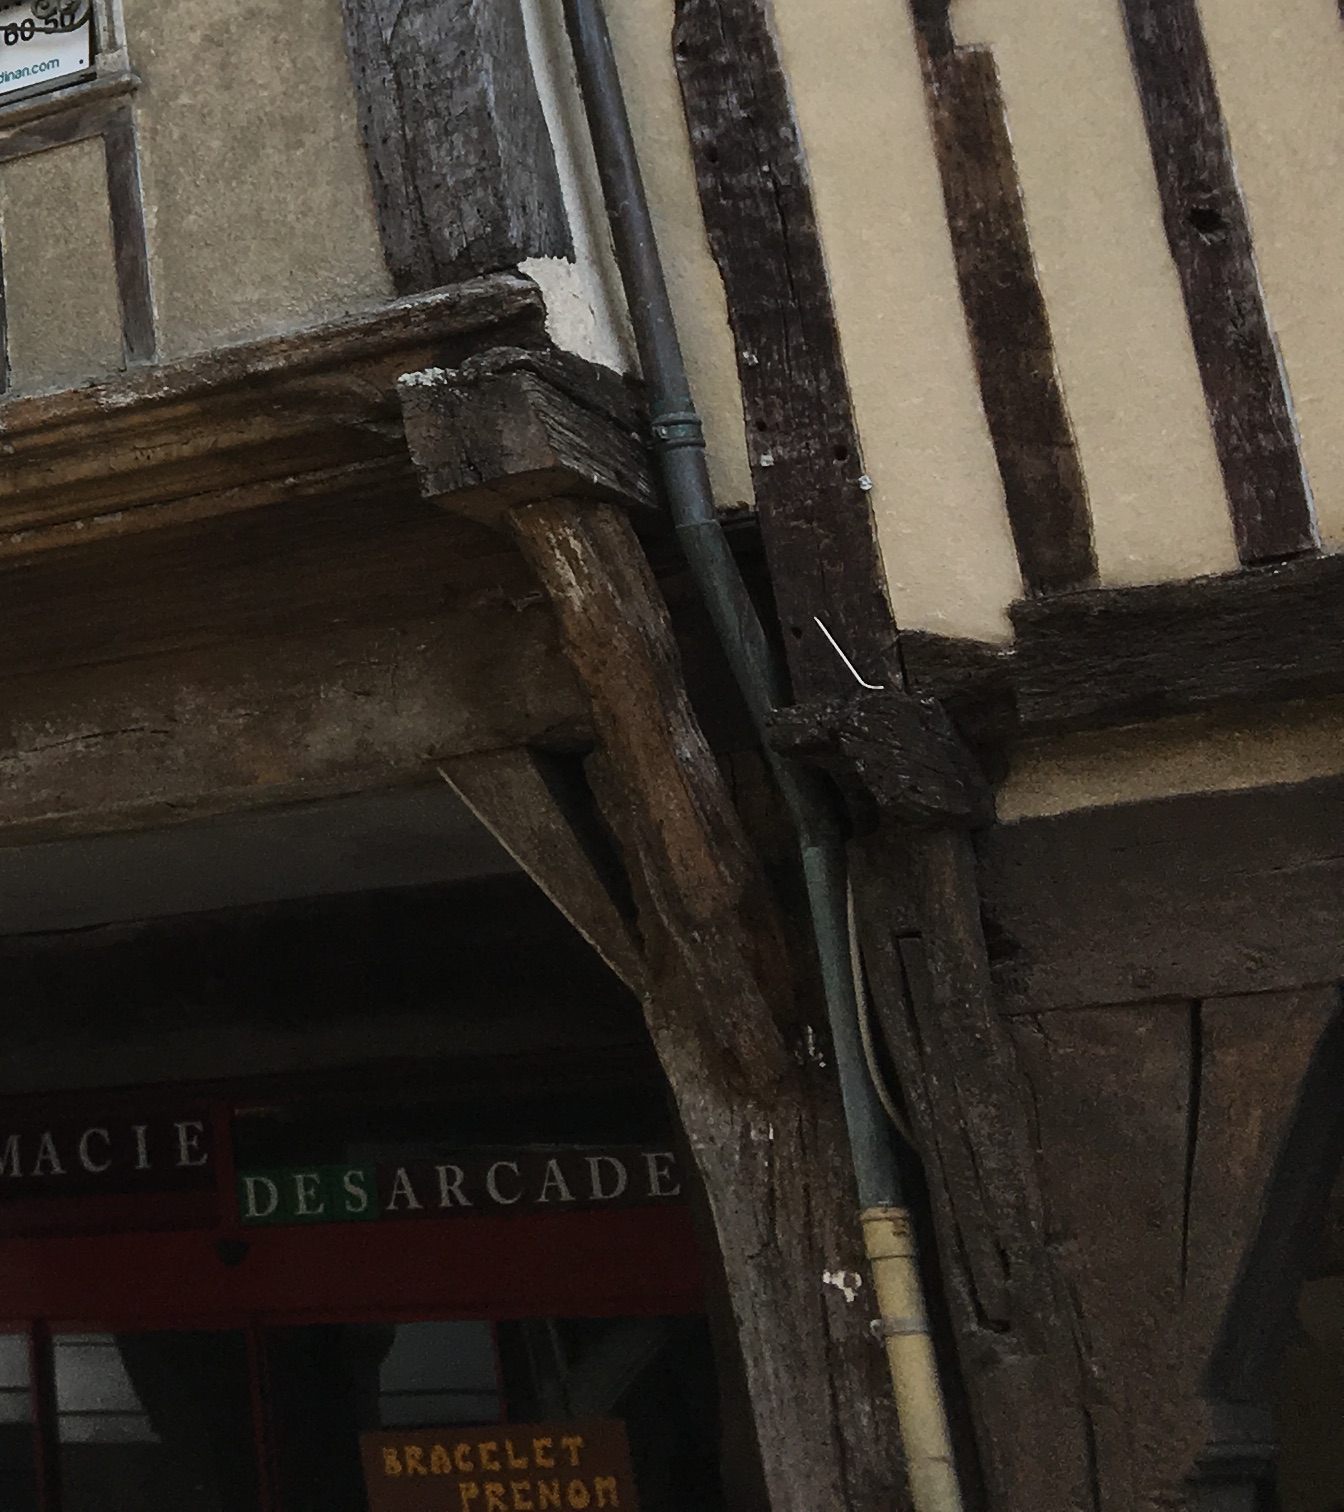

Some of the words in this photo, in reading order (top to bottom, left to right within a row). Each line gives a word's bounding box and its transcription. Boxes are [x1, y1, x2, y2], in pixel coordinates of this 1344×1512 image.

[242, 1169, 370, 1219] DES
[385, 1151, 683, 1211] ARCADE
[382, 1433, 585, 1477] BRACELET
[457, 1474, 620, 1512] PRENOM
